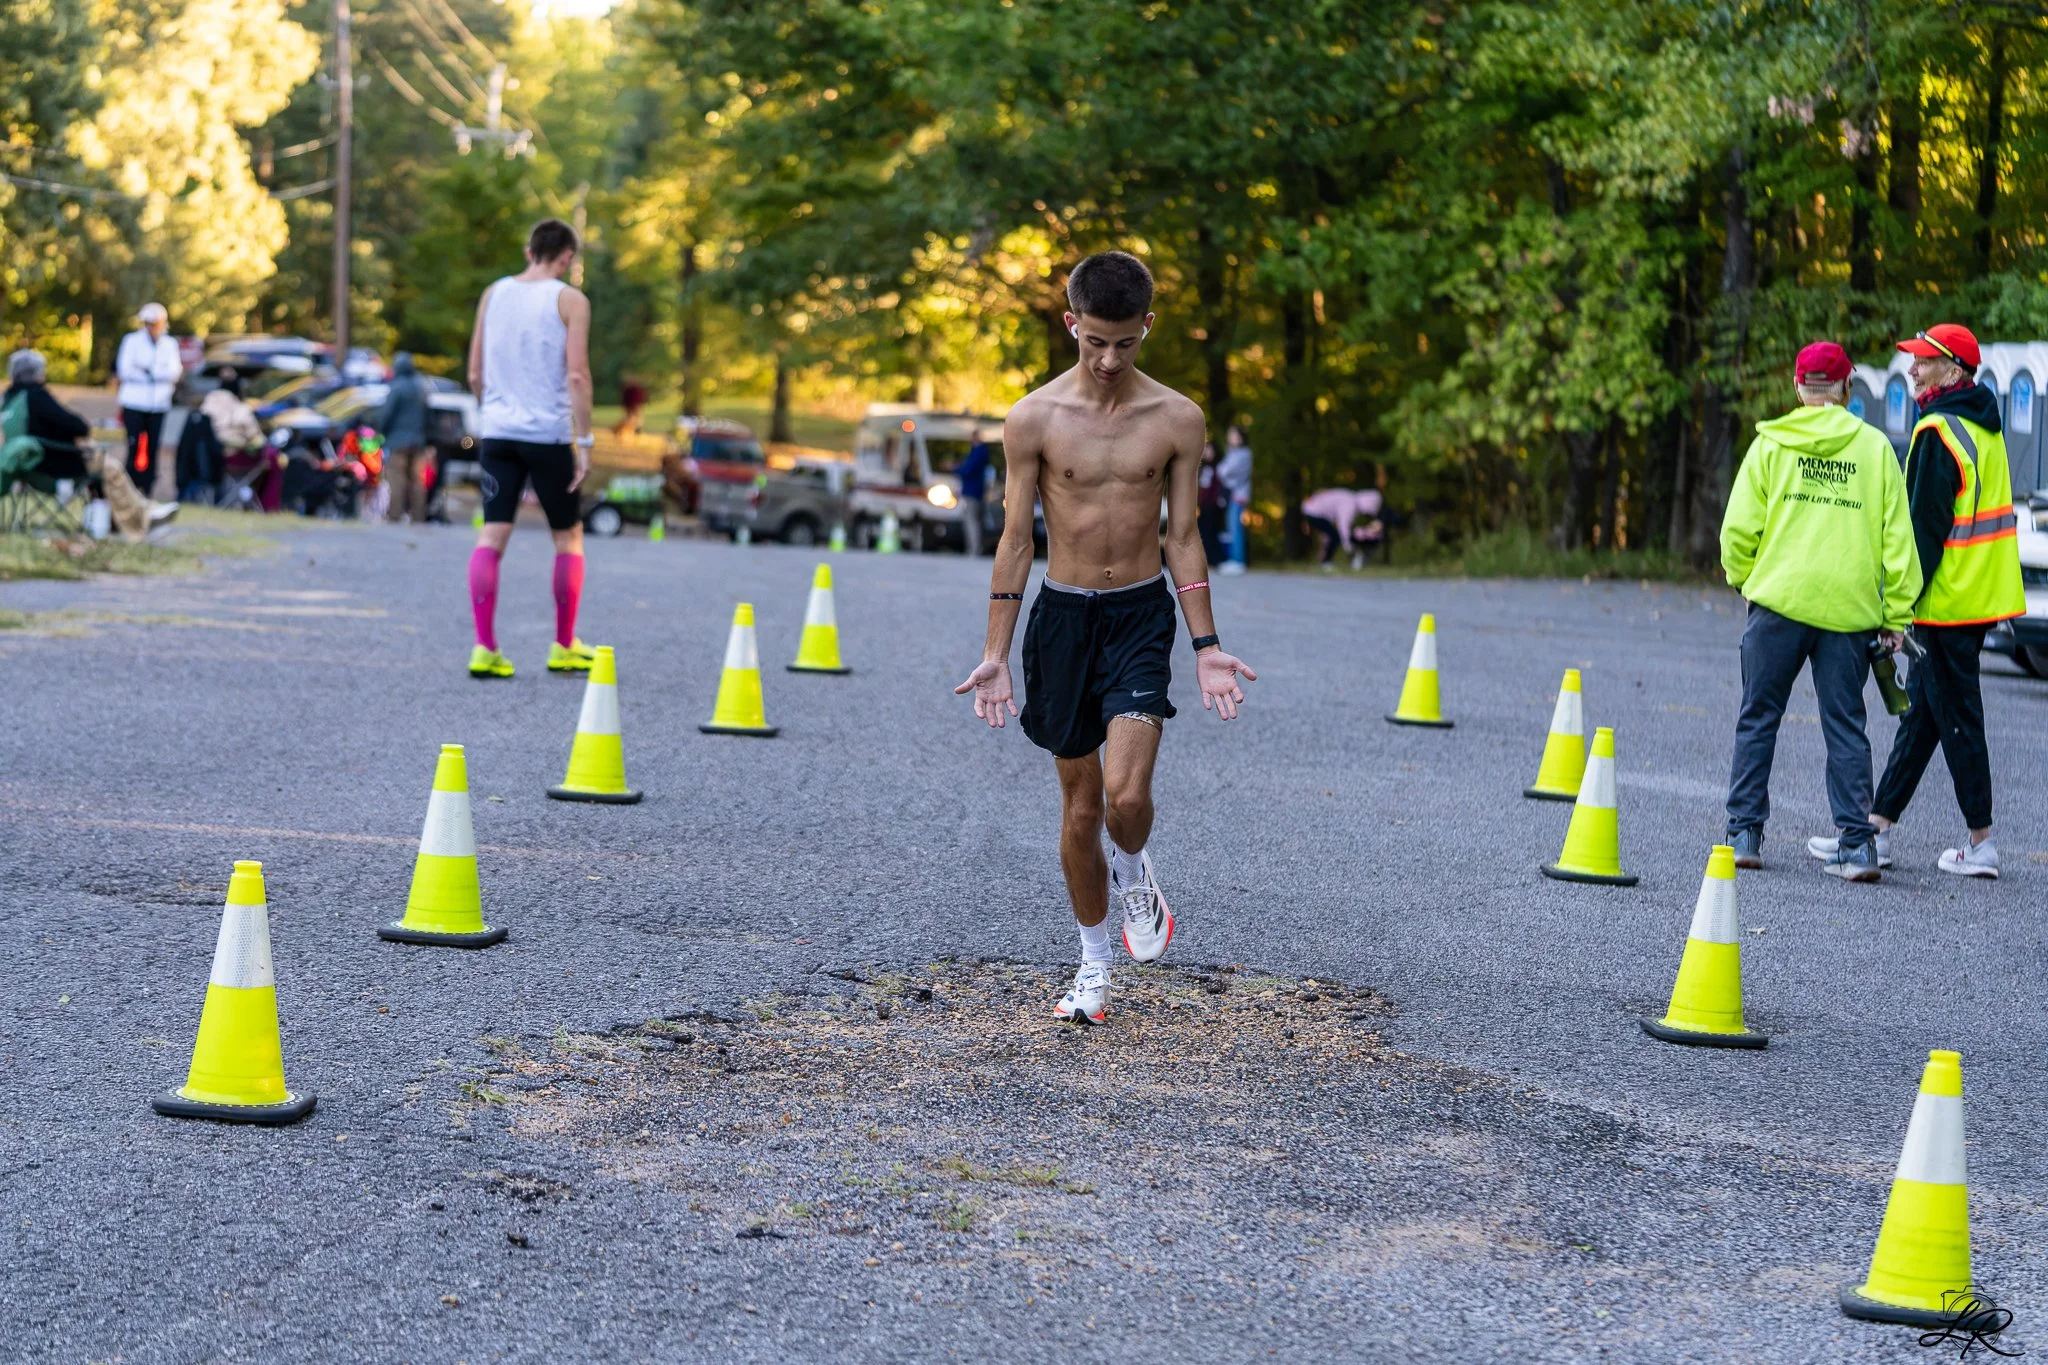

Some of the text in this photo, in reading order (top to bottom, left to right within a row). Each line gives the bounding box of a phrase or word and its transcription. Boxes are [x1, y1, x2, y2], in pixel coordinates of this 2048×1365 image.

[1798, 457, 1856, 475] MEMPHIS
[1802, 468, 1848, 484] RUNNERS
[1812, 495, 1833, 505] LINE
[1834, 498, 1862, 510] CREW
